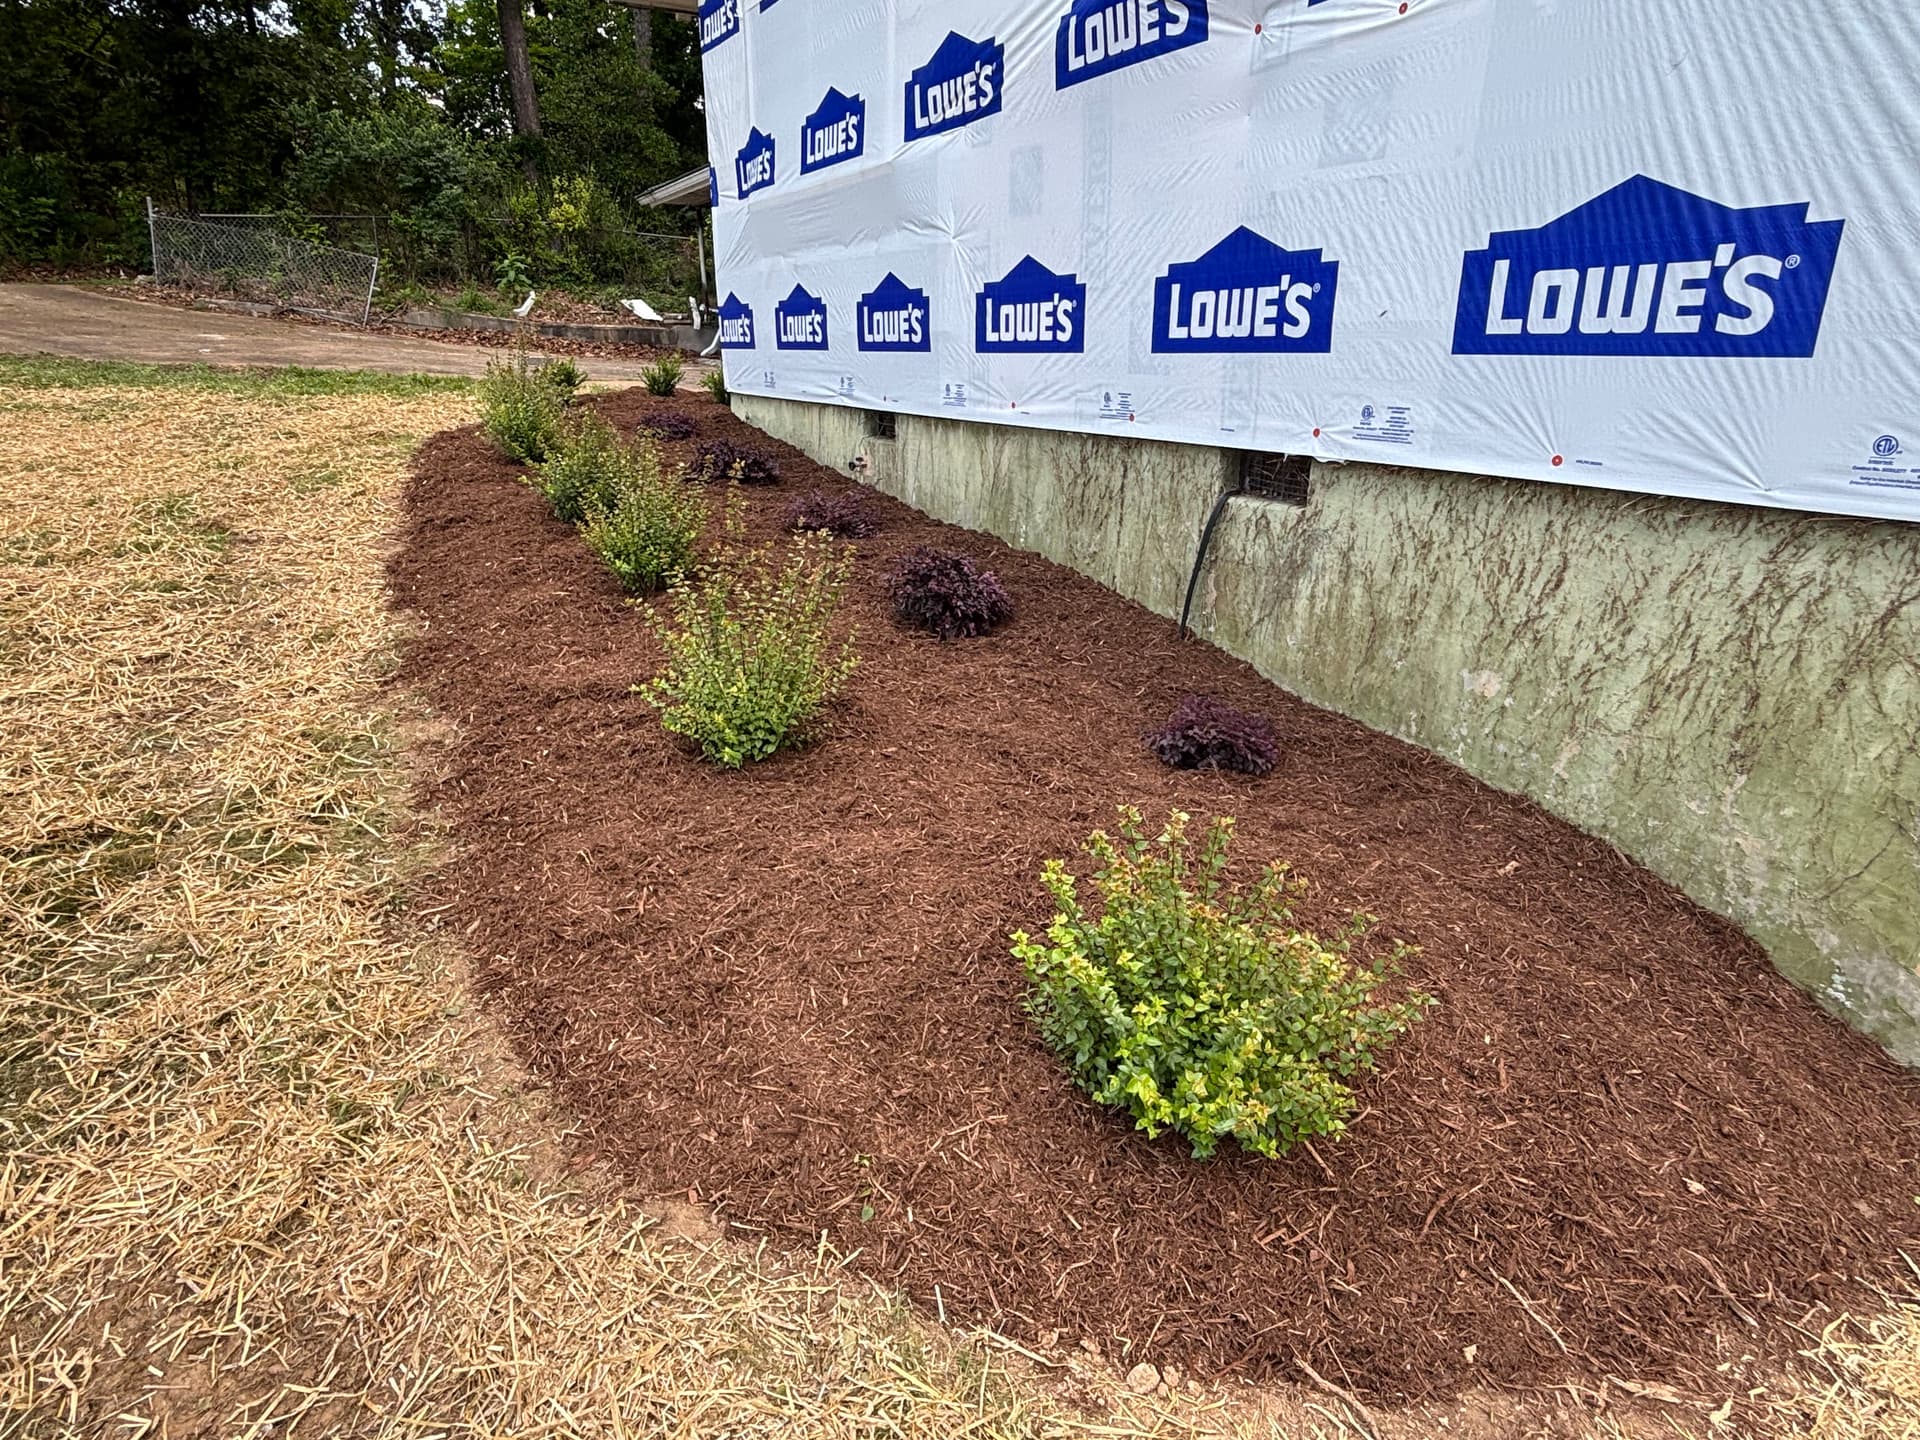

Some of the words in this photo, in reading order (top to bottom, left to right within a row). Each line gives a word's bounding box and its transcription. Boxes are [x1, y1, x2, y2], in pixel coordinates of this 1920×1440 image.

[1068, 0, 1190, 72] LOWES
[914, 60, 994, 129] LOWE'S
[806, 112, 858, 165] LOWE'S
[740, 147, 771, 191] LOWE'S
[1168, 274, 1311, 339] LOWE'S
[1485, 243, 1782, 336] LOWE'S
[719, 313, 751, 343] LOWE'S
[779, 309, 823, 343] LOWE'S
[863, 303, 922, 343] LOWE'S
[983, 293, 1073, 342] LOWE'S
